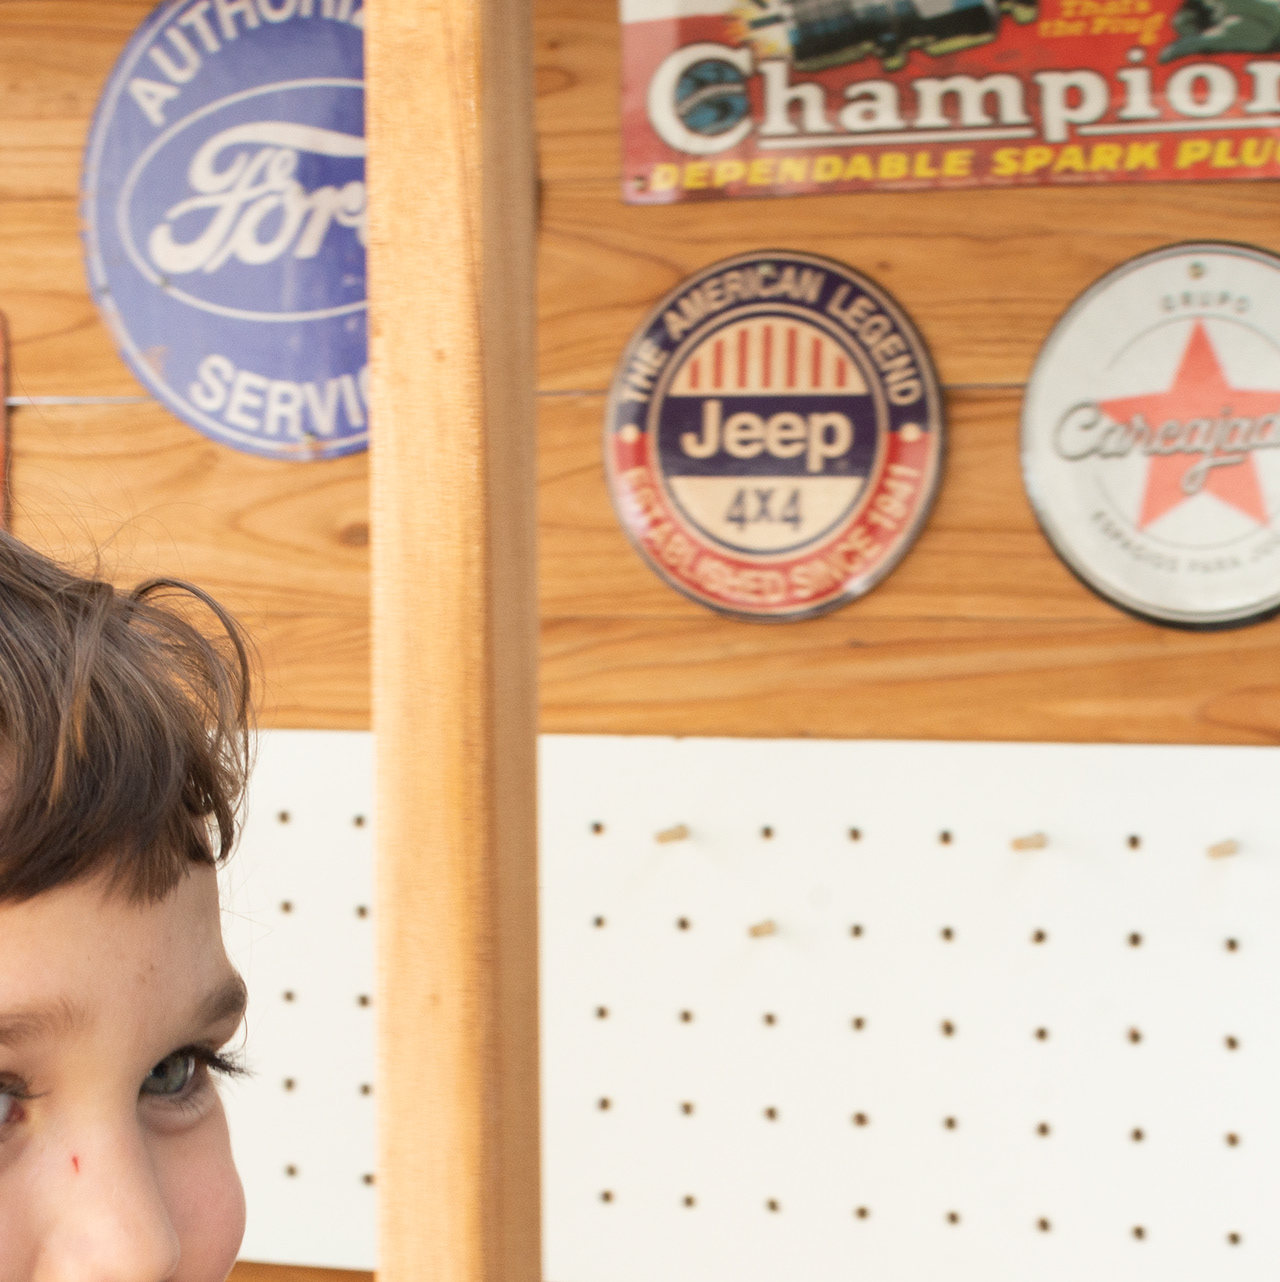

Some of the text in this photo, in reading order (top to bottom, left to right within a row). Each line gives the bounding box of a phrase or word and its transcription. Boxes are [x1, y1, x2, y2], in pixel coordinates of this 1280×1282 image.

[149, 120, 365, 275] For
[650, 149, 975, 191] DEPENDABLE
[992, 141, 1160, 177] SPARK
[623, 266, 921, 406] THE AMERICAN LEGEND
[681, 399, 854, 473] Jeep
